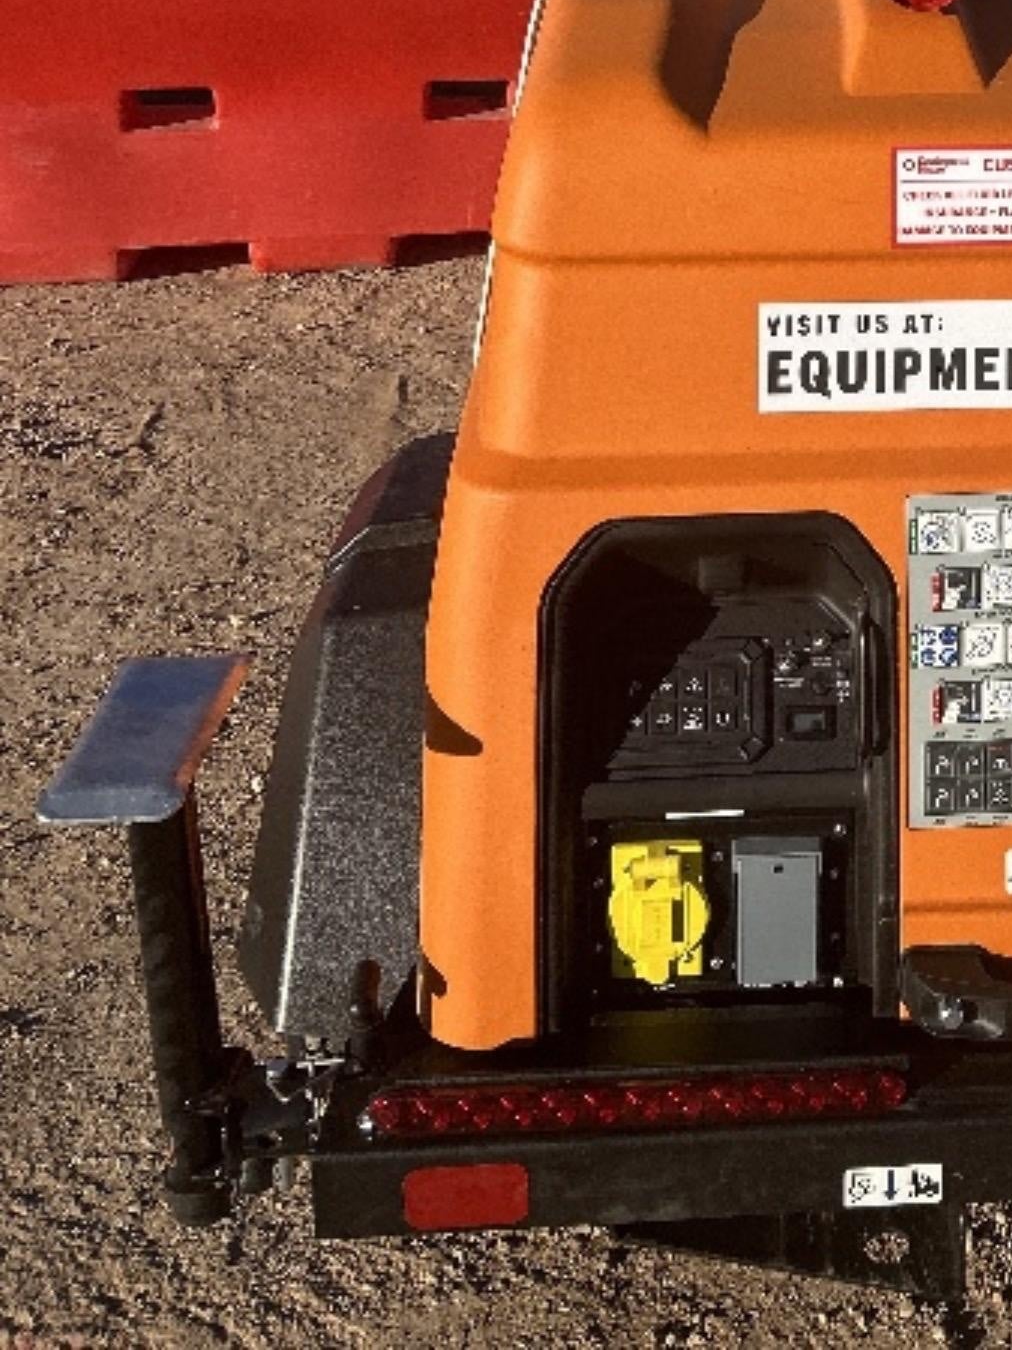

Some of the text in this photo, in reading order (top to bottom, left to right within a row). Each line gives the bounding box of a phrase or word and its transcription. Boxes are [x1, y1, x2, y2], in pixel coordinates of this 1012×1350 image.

[766, 313, 945, 337] VISIT US AT:
